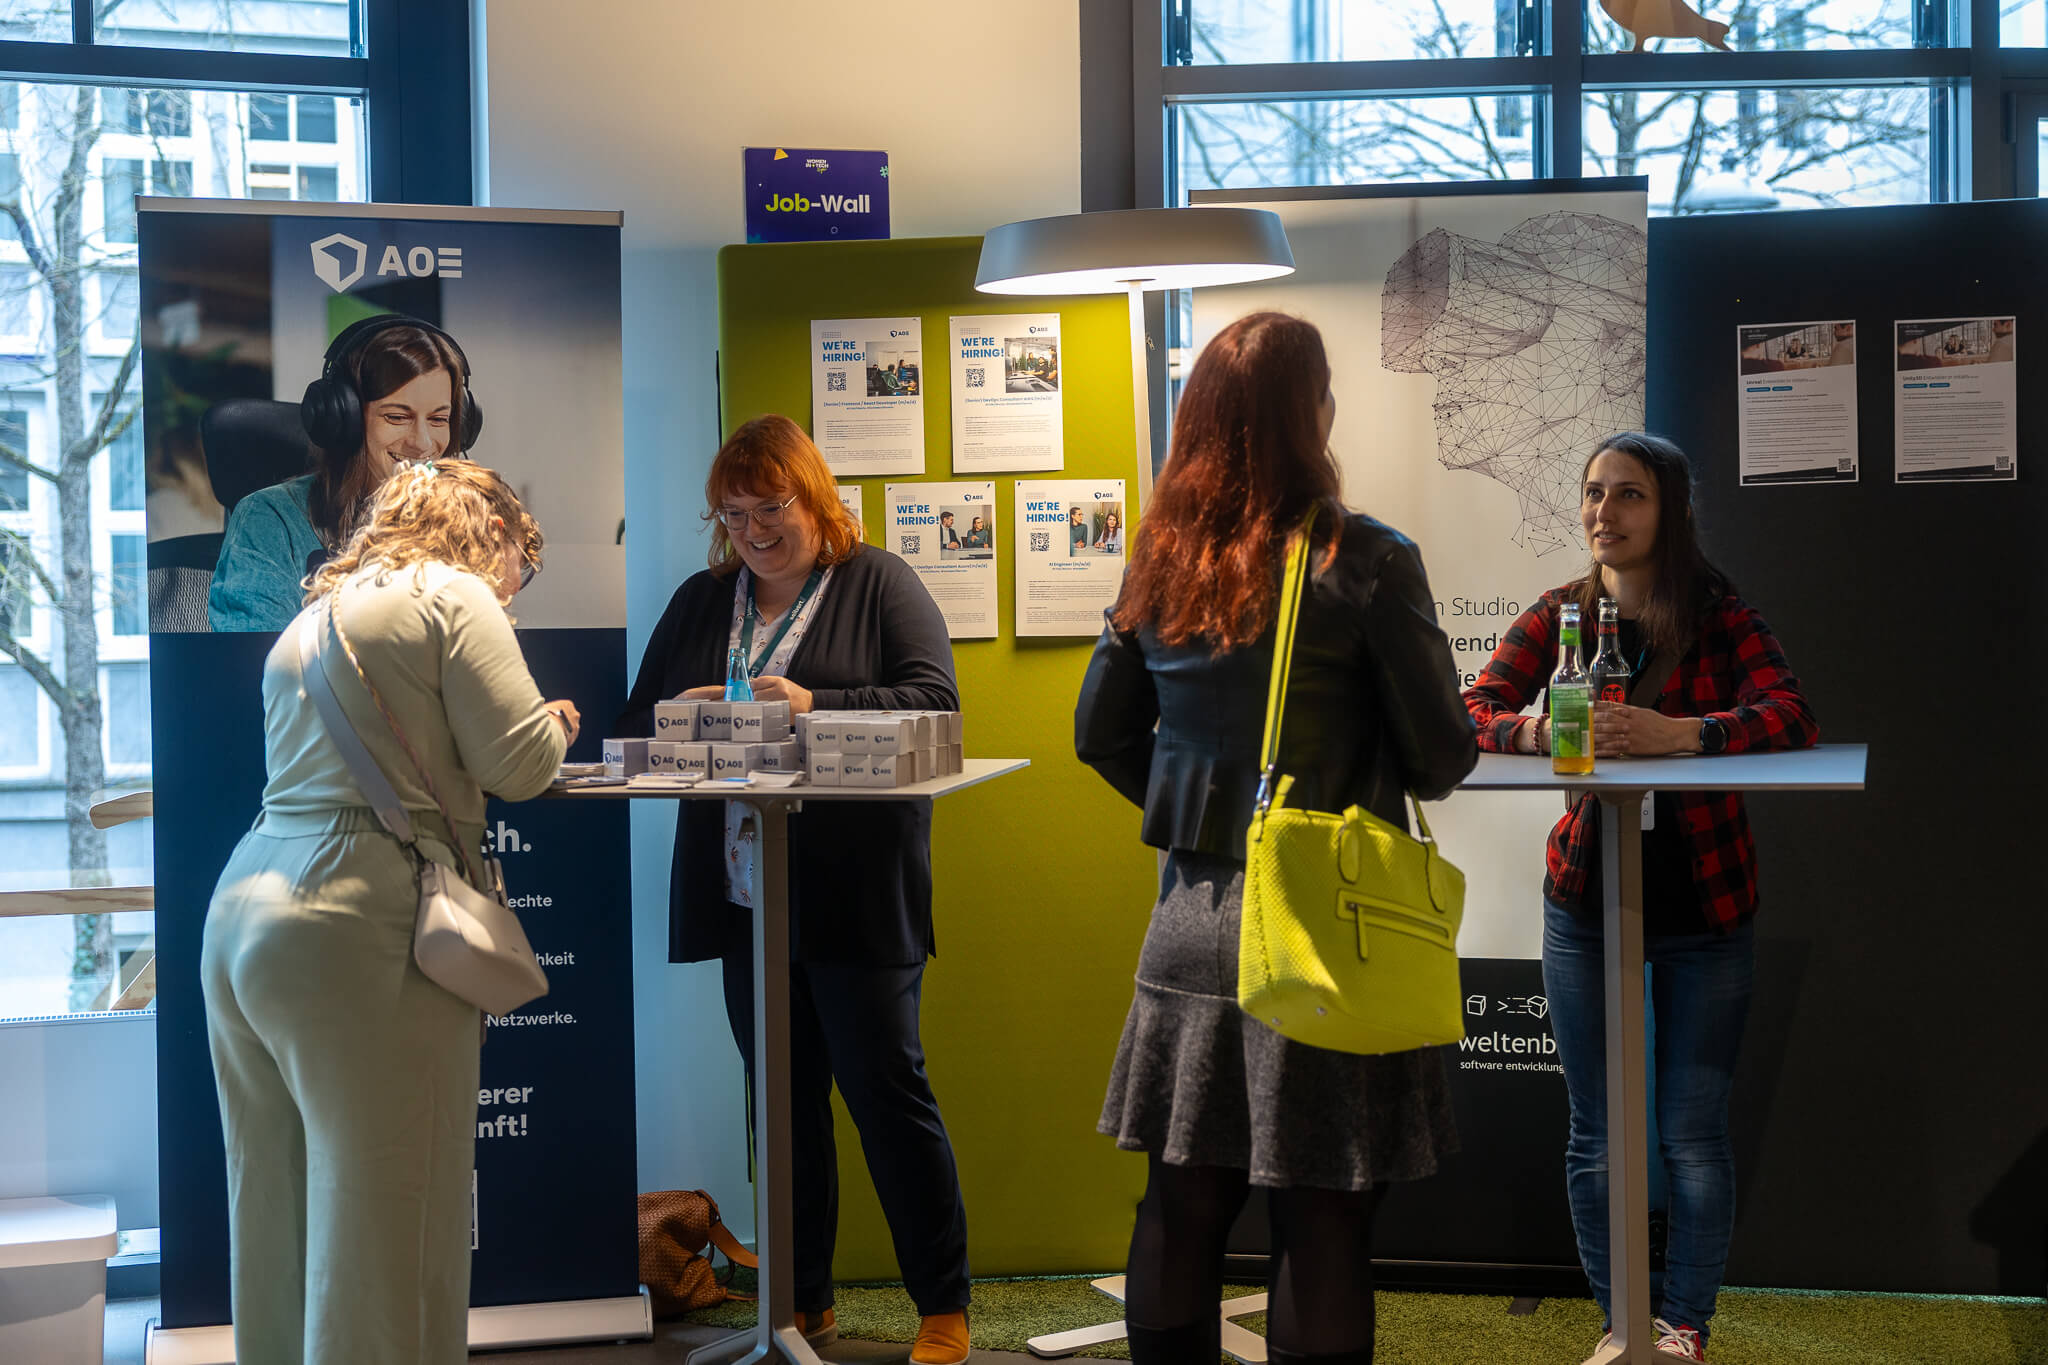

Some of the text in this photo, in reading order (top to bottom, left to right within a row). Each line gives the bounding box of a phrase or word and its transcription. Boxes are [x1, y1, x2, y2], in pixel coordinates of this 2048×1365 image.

[765, 193, 870, 213] Job-Wall
[377, 245, 462, 278] AOE
[822, 341, 856, 350] WE'RE
[961, 336, 995, 347] WE'RE
[822, 353, 865, 362] HIRING!
[961, 348, 1004, 358] HIRING!
[896, 504, 930, 514] WE'RE
[1026, 501, 1060, 511] WE'RE
[896, 516, 939, 526] HIRING!
[1026, 513, 1069, 523] HIRING!
[1452, 596, 1520, 616] Studio
[671, 718, 688, 726] AOE
[745, 718, 760, 727] AOE
[662, 756, 674, 764] AO
[688, 760, 704, 768] AOE
[727, 760, 743, 768] AOE
[480, 821, 532, 853] ch.
[535, 951, 575, 966] hkeit
[1458, 1031, 1557, 1054] weltenb
[1460, 1060, 1565, 1074] software entwicklung
[477, 1086, 534, 1105] erer
[473, 1114, 528, 1138] nft!
